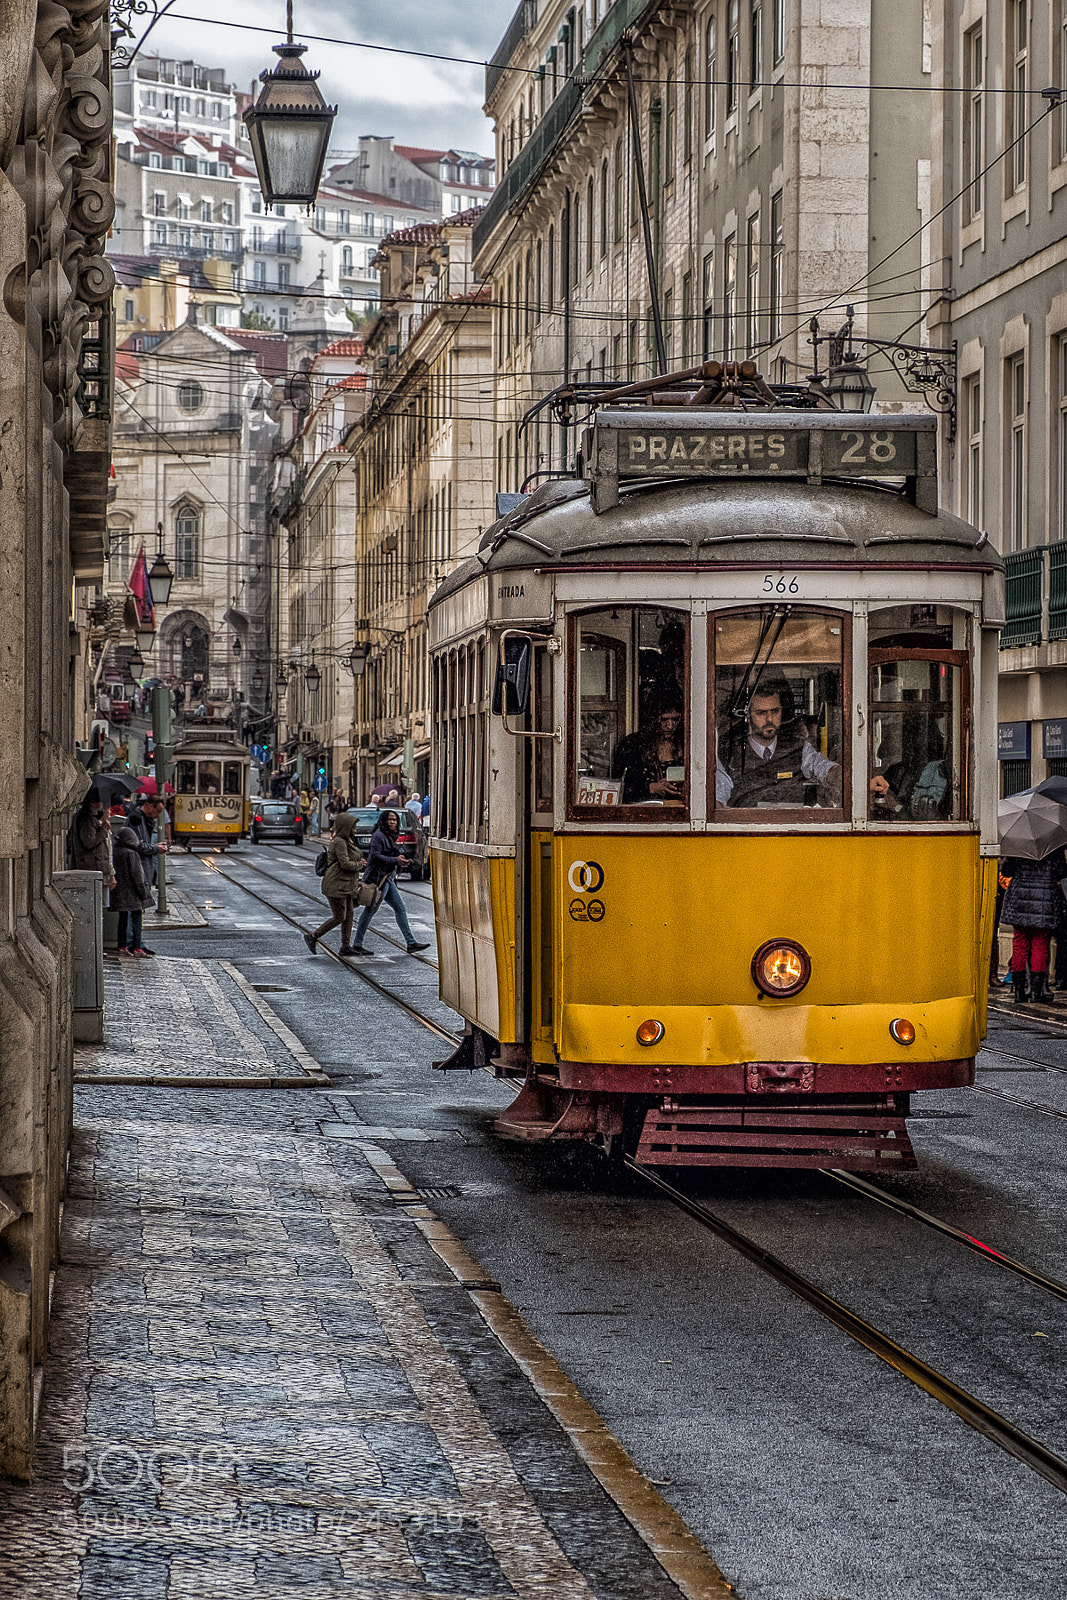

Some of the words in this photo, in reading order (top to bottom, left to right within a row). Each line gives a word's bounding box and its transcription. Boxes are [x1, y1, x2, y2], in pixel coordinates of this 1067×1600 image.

[628, 434, 786, 460] PRAZERES
[839, 431, 897, 464] 28
[497, 585, 525, 599] ENTRADA
[762, 574, 799, 594] 566
[187, 797, 242, 813] JAMESON
